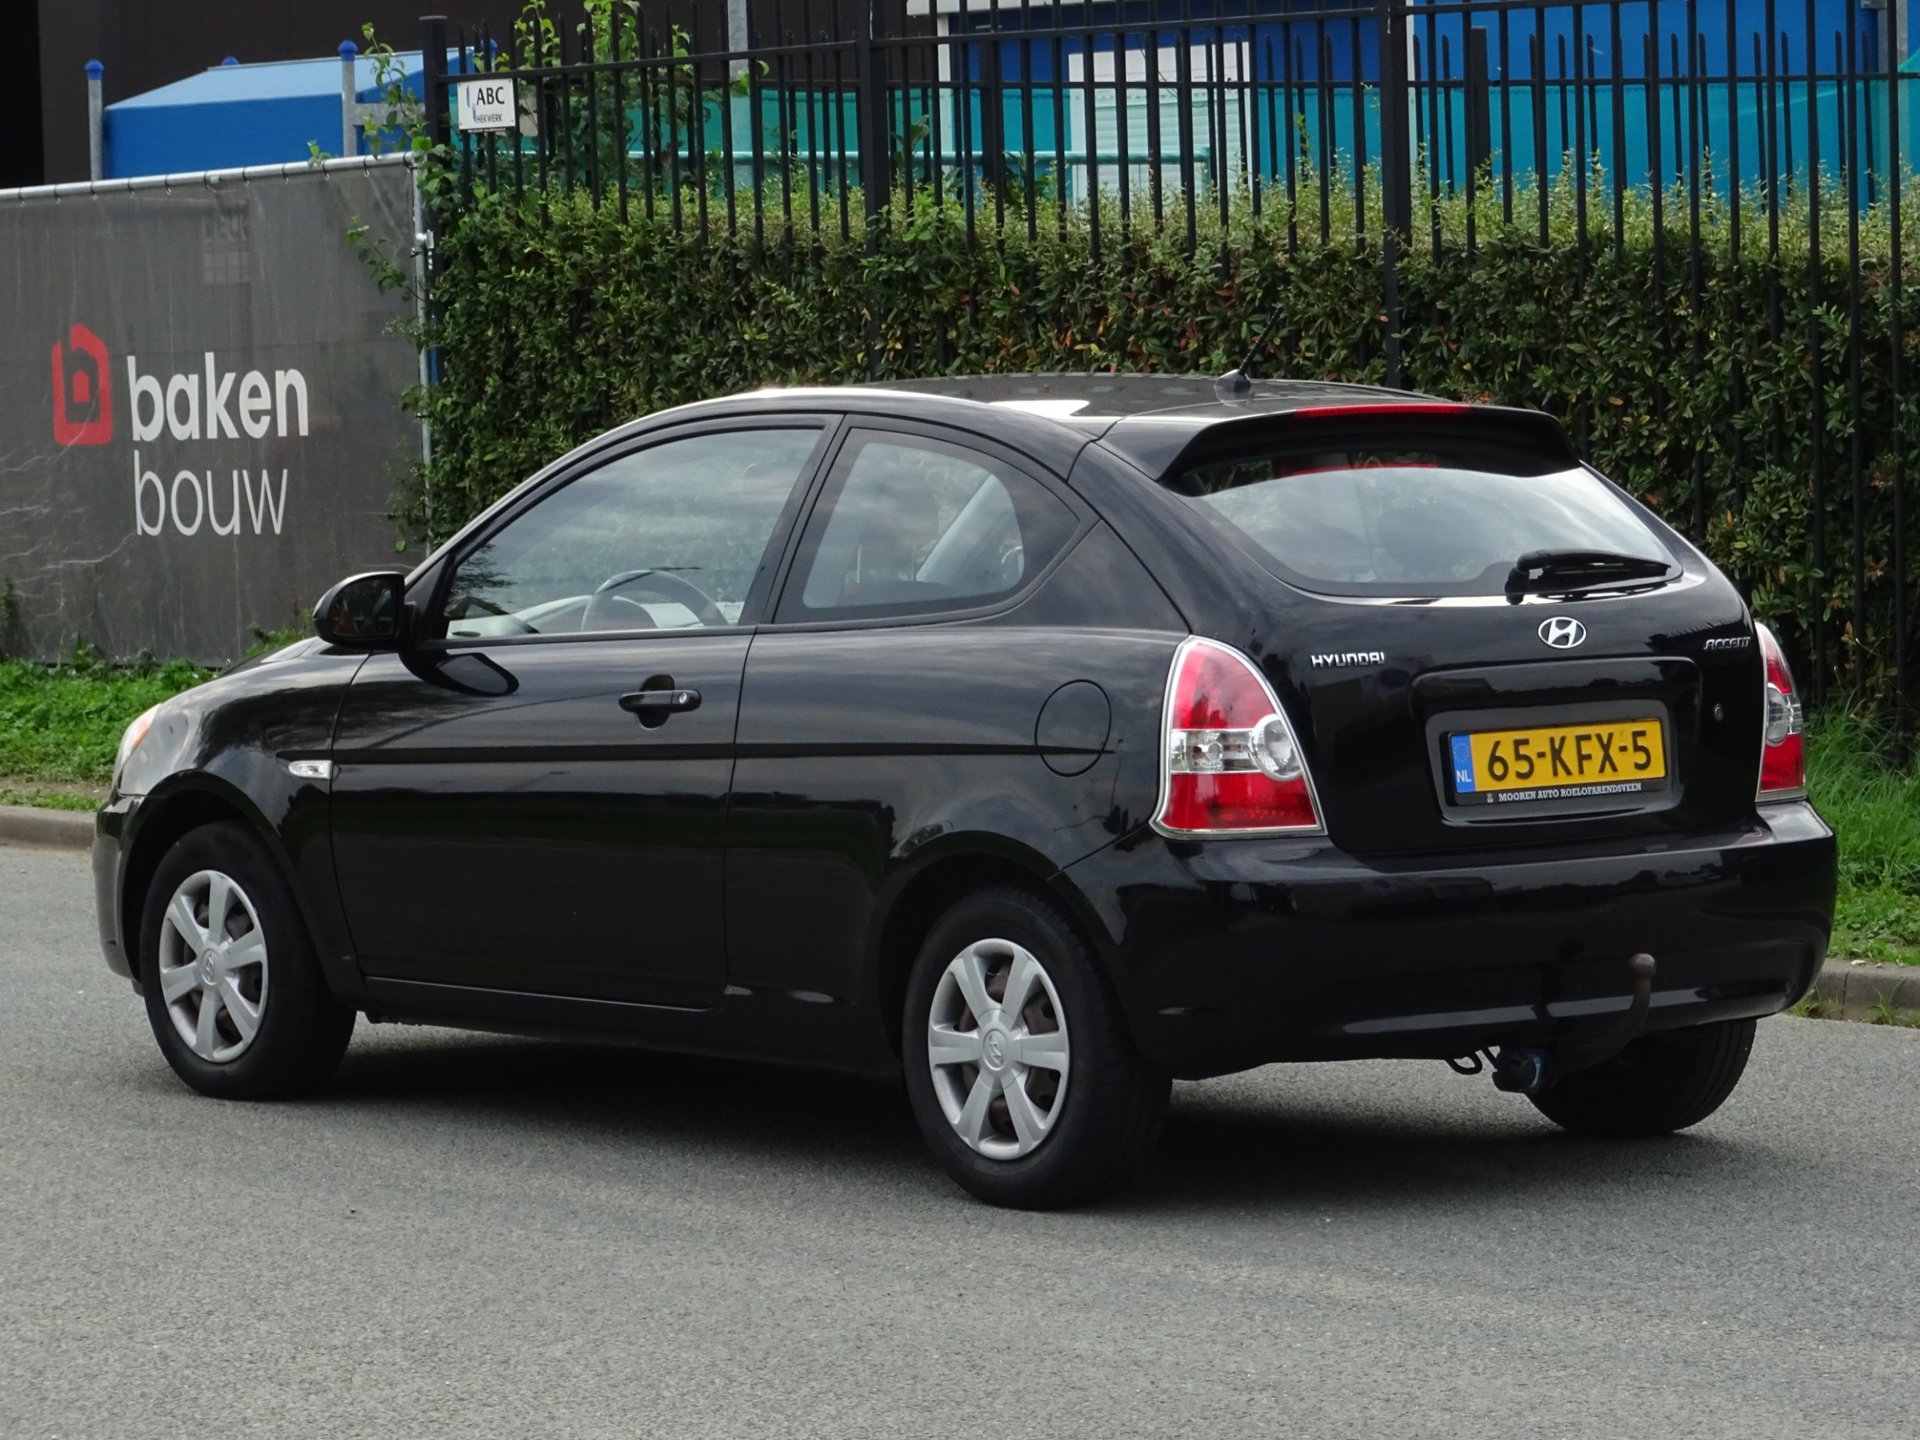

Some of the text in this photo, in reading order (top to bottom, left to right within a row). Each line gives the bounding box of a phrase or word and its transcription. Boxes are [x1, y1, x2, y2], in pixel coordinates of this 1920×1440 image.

[476, 86, 505, 105] ABC
[476, 113, 503, 123] HEKWERK
[127, 352, 309, 441] baken
[134, 449, 288, 536] bouw
[1310, 651, 1385, 668] HYUNDAI
[1487, 730, 1652, 781] 65-KFX-5
[1456, 769, 1472, 784] NL
[1498, 782, 1642, 802] MOOREN AUTO ROELOFARENDSVEEN
